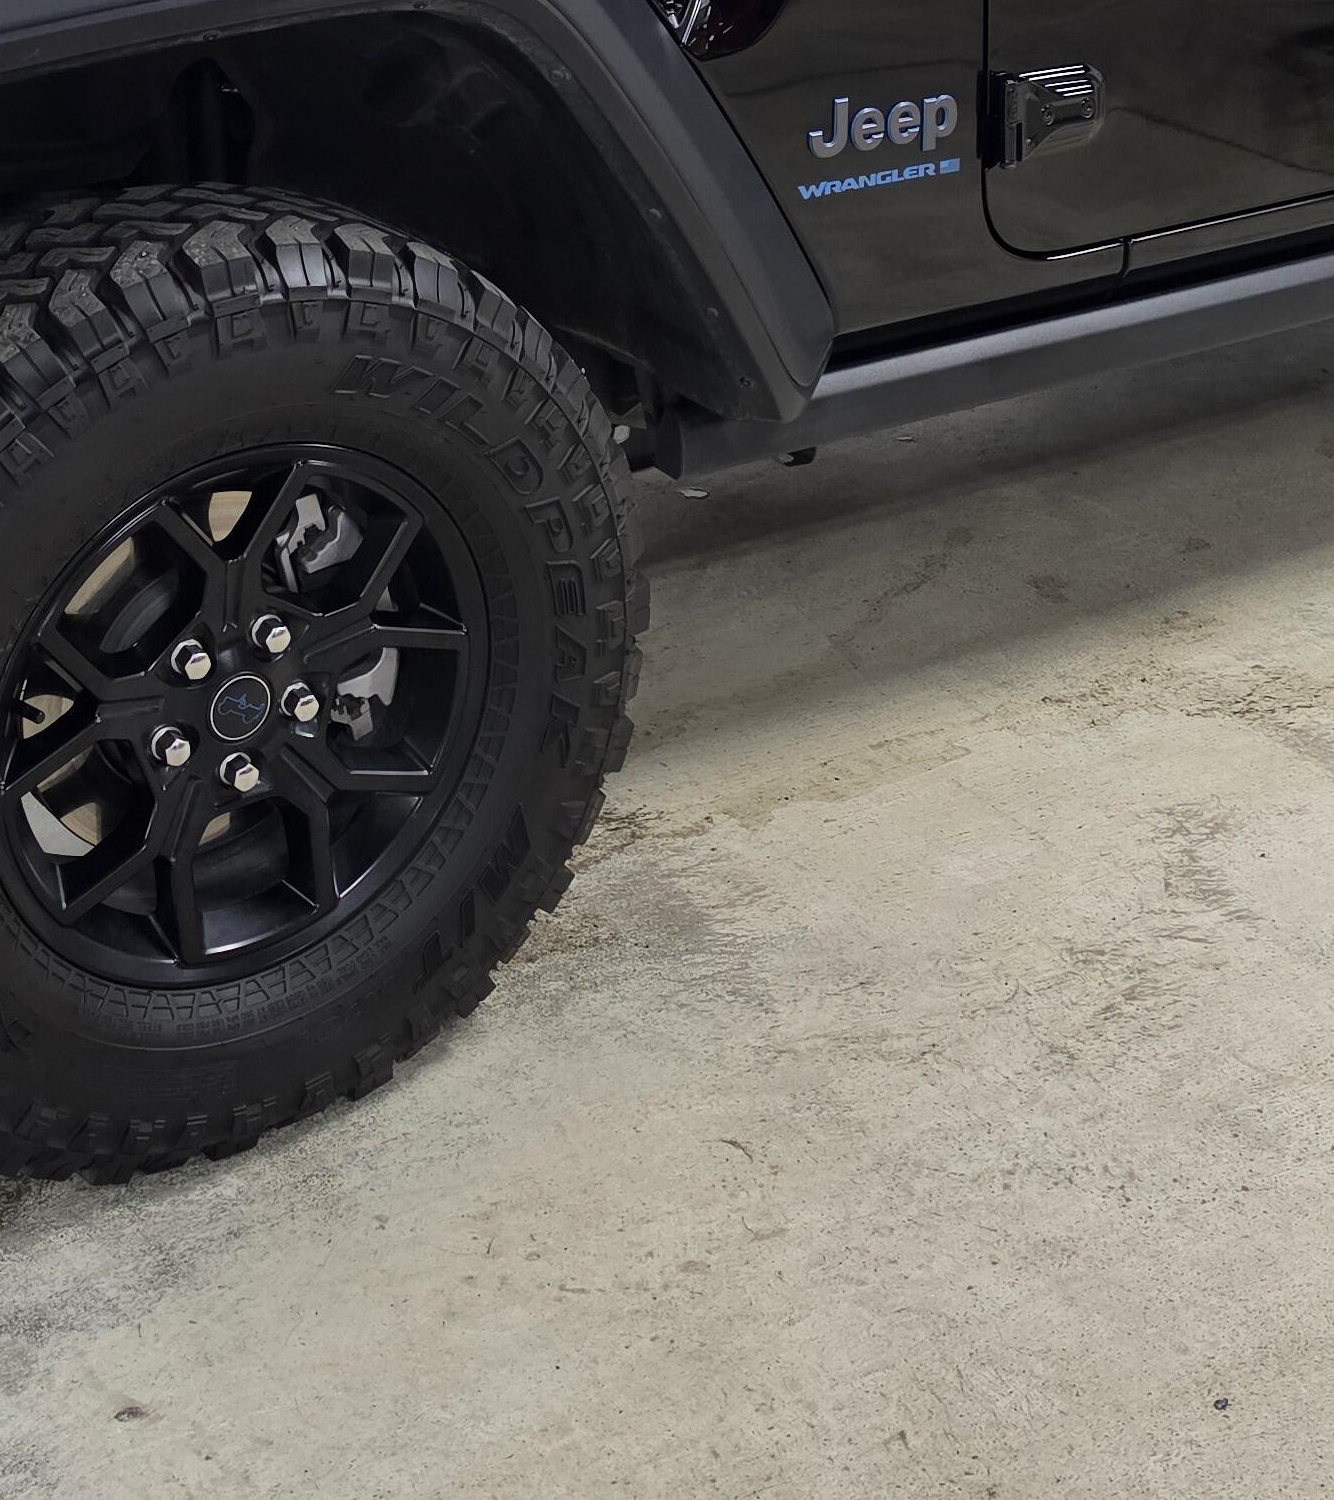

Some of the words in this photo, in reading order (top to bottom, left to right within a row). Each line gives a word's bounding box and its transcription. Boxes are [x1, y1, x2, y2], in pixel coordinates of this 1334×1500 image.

[808, 94, 958, 159] Jeep
[797, 162, 936, 200] WRANGLER
[329, 353, 588, 770] WILDPEAK
